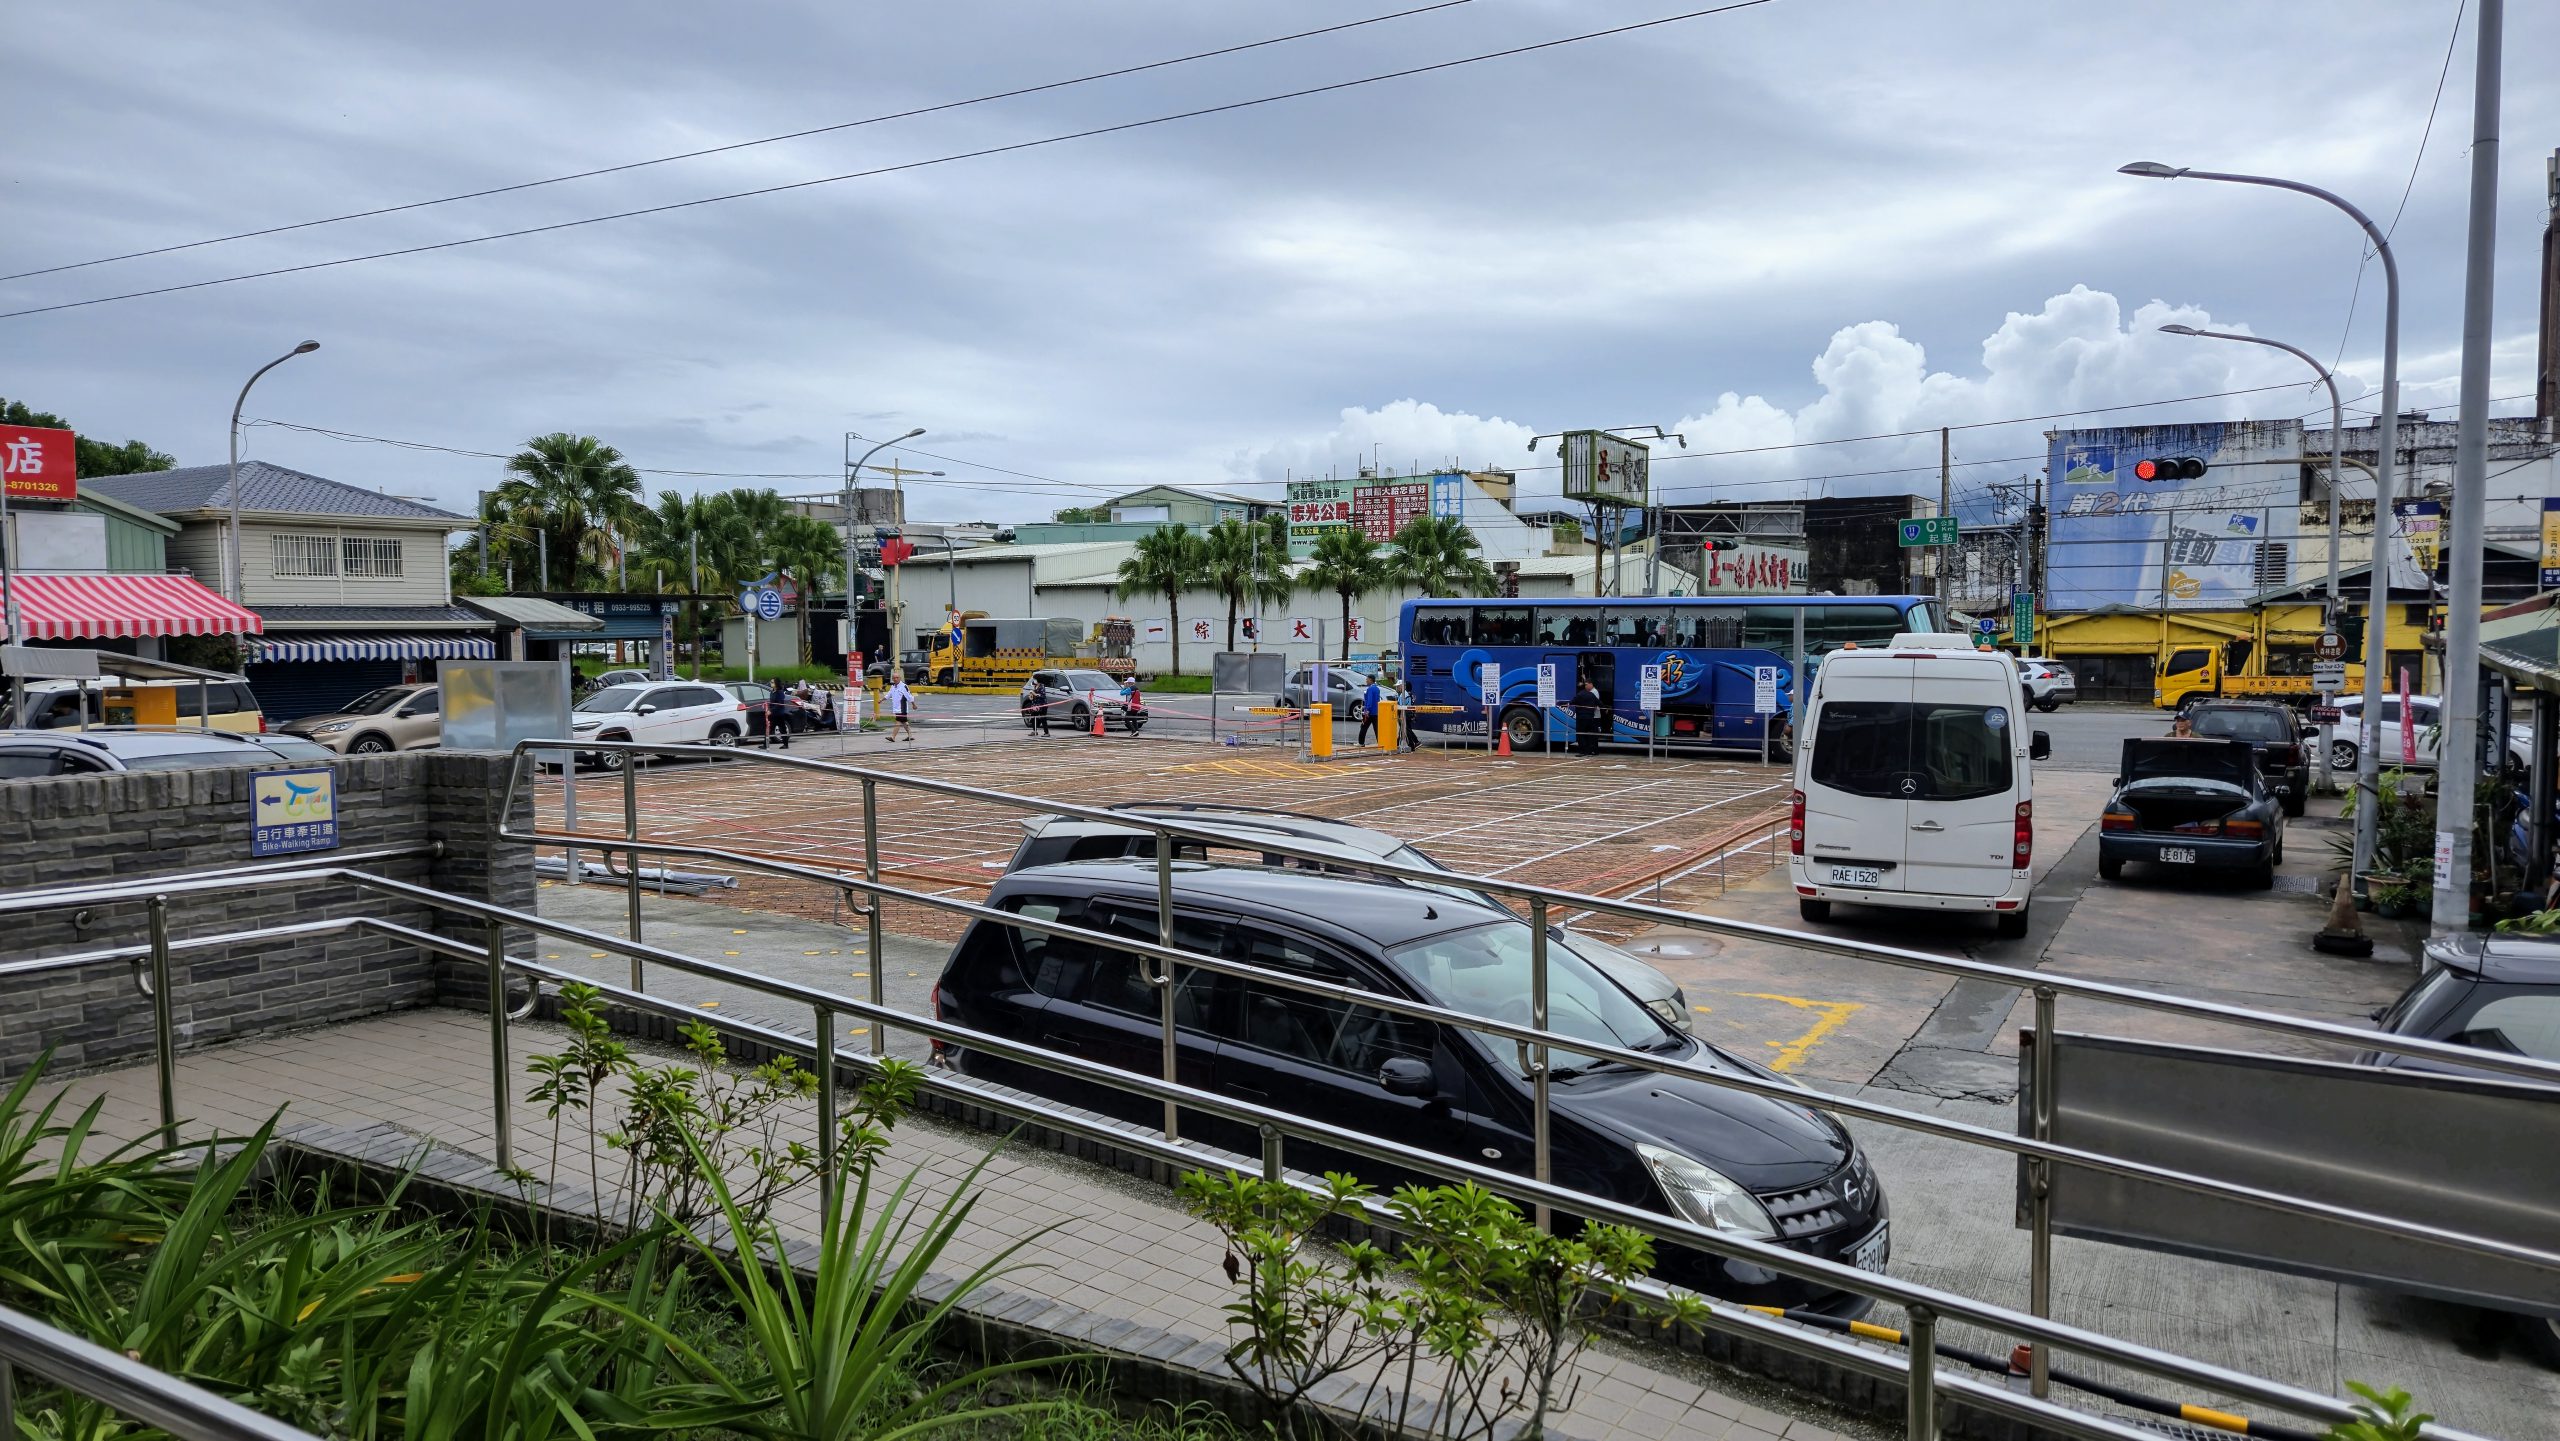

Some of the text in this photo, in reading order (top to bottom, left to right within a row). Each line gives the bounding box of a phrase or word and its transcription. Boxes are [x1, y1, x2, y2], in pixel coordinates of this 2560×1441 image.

[5, 436, 43, 474] 店
[1290, 502, 1350, 523] 志光公職
[1926, 520, 1936, 533] 0
[1929, 533, 1953, 543] 起點
